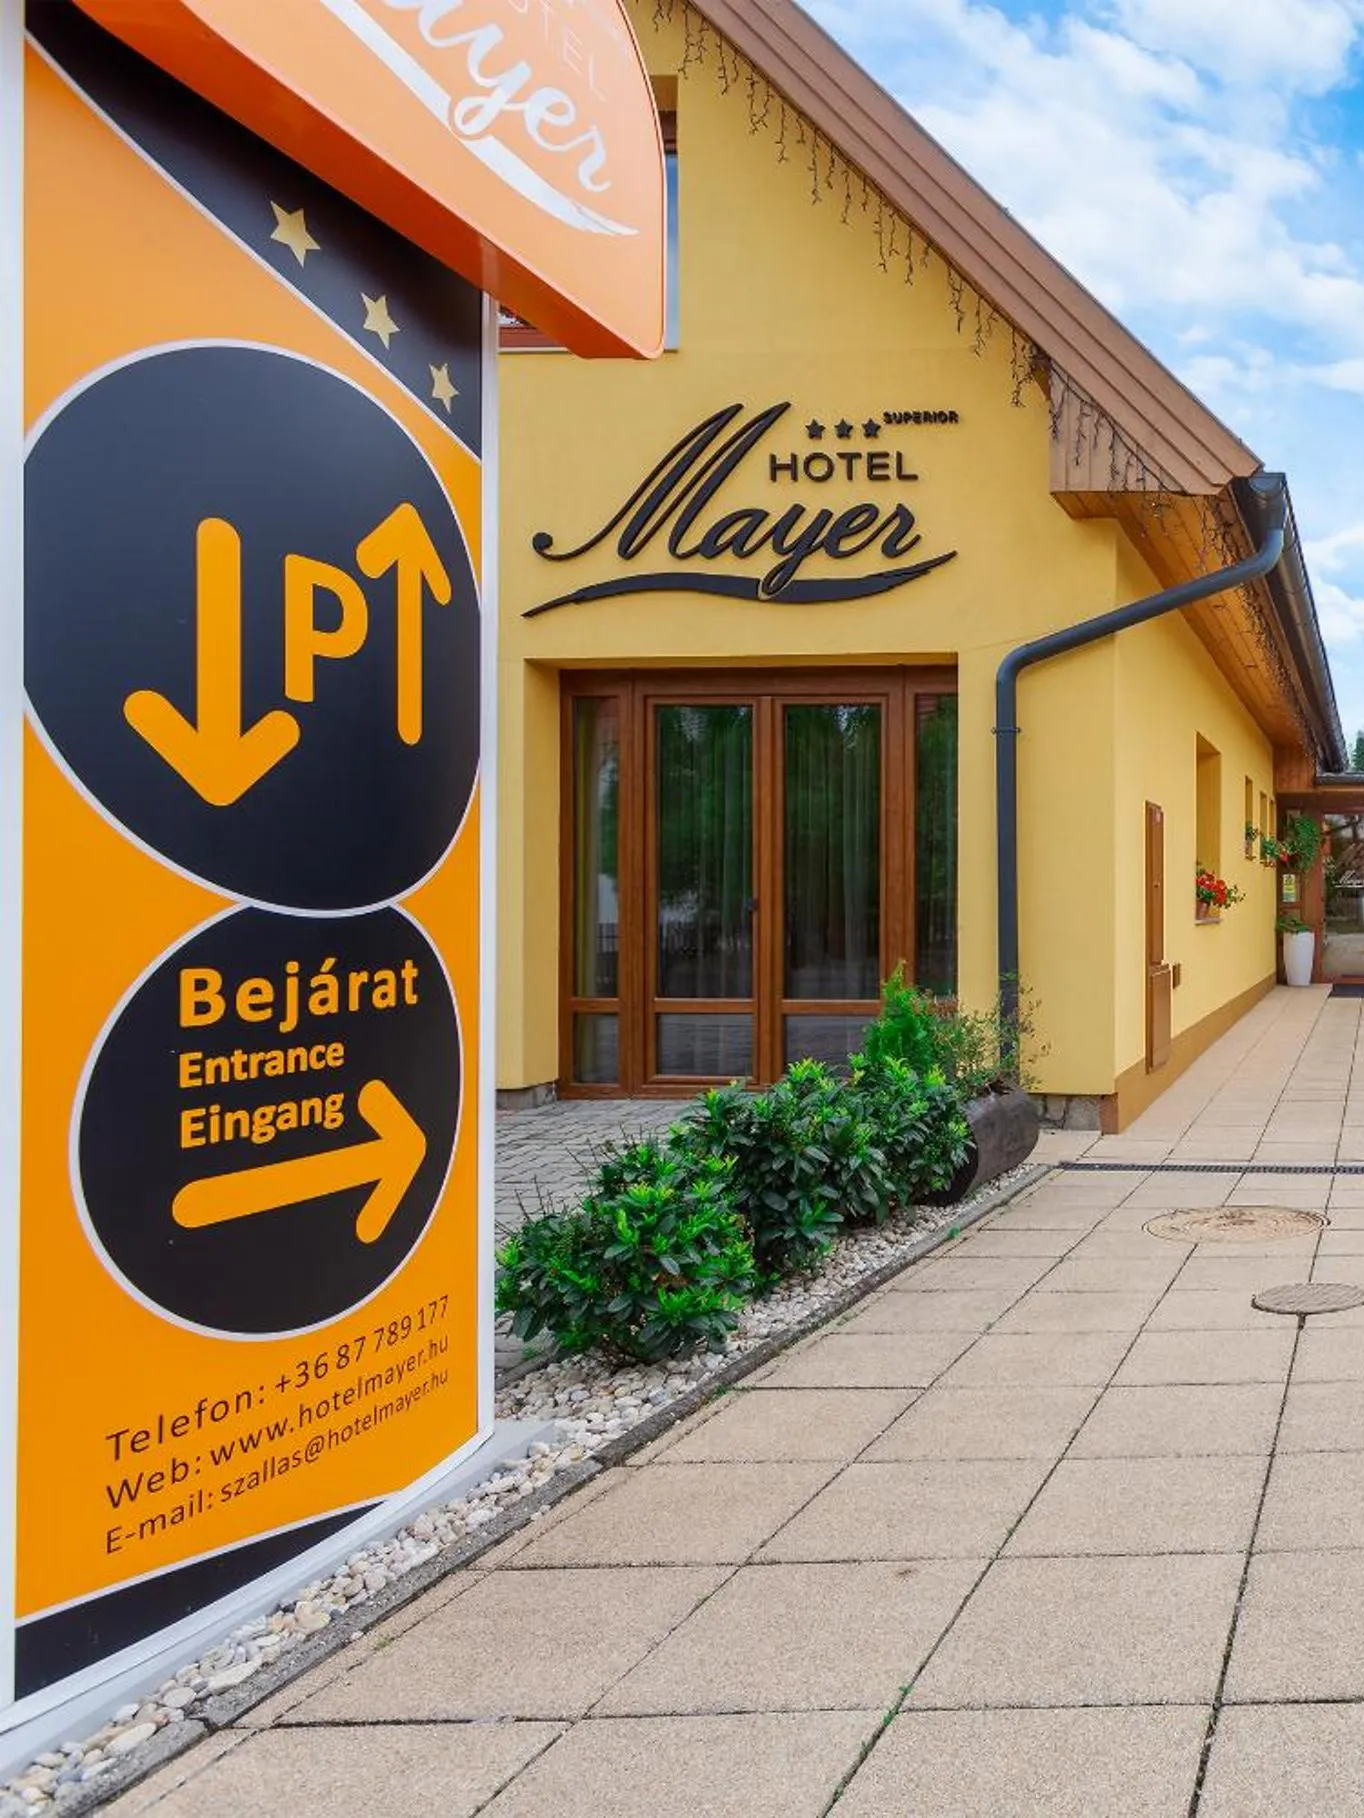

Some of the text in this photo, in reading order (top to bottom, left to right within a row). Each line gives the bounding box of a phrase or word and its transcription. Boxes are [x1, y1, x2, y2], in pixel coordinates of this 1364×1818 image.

[769, 451, 919, 483] HOTEL
[882, 410, 960, 425] SUPERIOR
[531, 401, 922, 599] Mayer
[284, 553, 369, 703] P
[179, 957, 419, 1033] Bejárat
[178, 1040, 345, 1088] Entrance
[179, 1091, 345, 1149] Eingang
[105, 1294, 449, 1461] Telefon: +36 87 789 177
[105, 1334, 449, 1510] Web: www.hotelmayer.hu
[105, 1368, 449, 1555] E-mail: szallas@hotelmayer.hu
